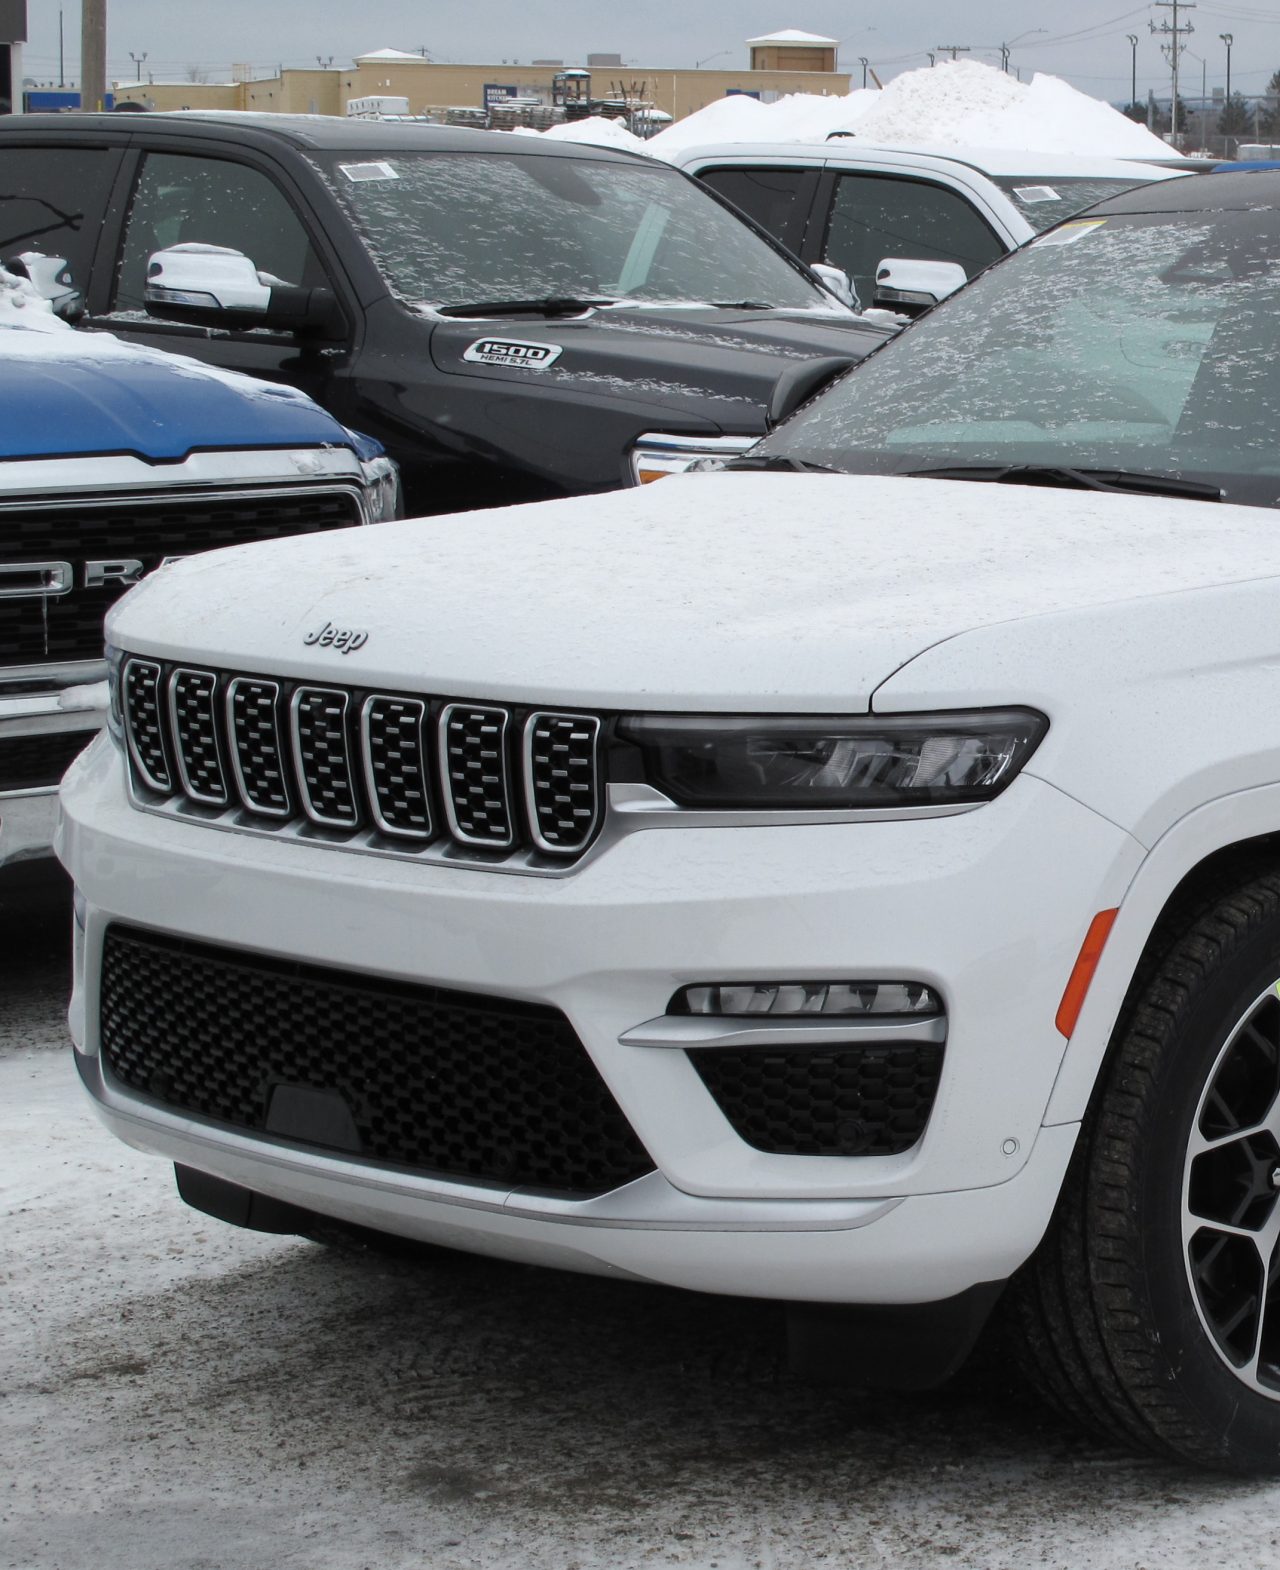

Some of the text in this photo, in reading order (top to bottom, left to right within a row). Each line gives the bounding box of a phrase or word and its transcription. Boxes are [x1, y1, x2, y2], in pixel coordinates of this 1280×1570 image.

[480, 353, 533, 366] HEMI 5.7L
[482, 343, 546, 360] 1500
[303, 621, 369, 655] Jeep
